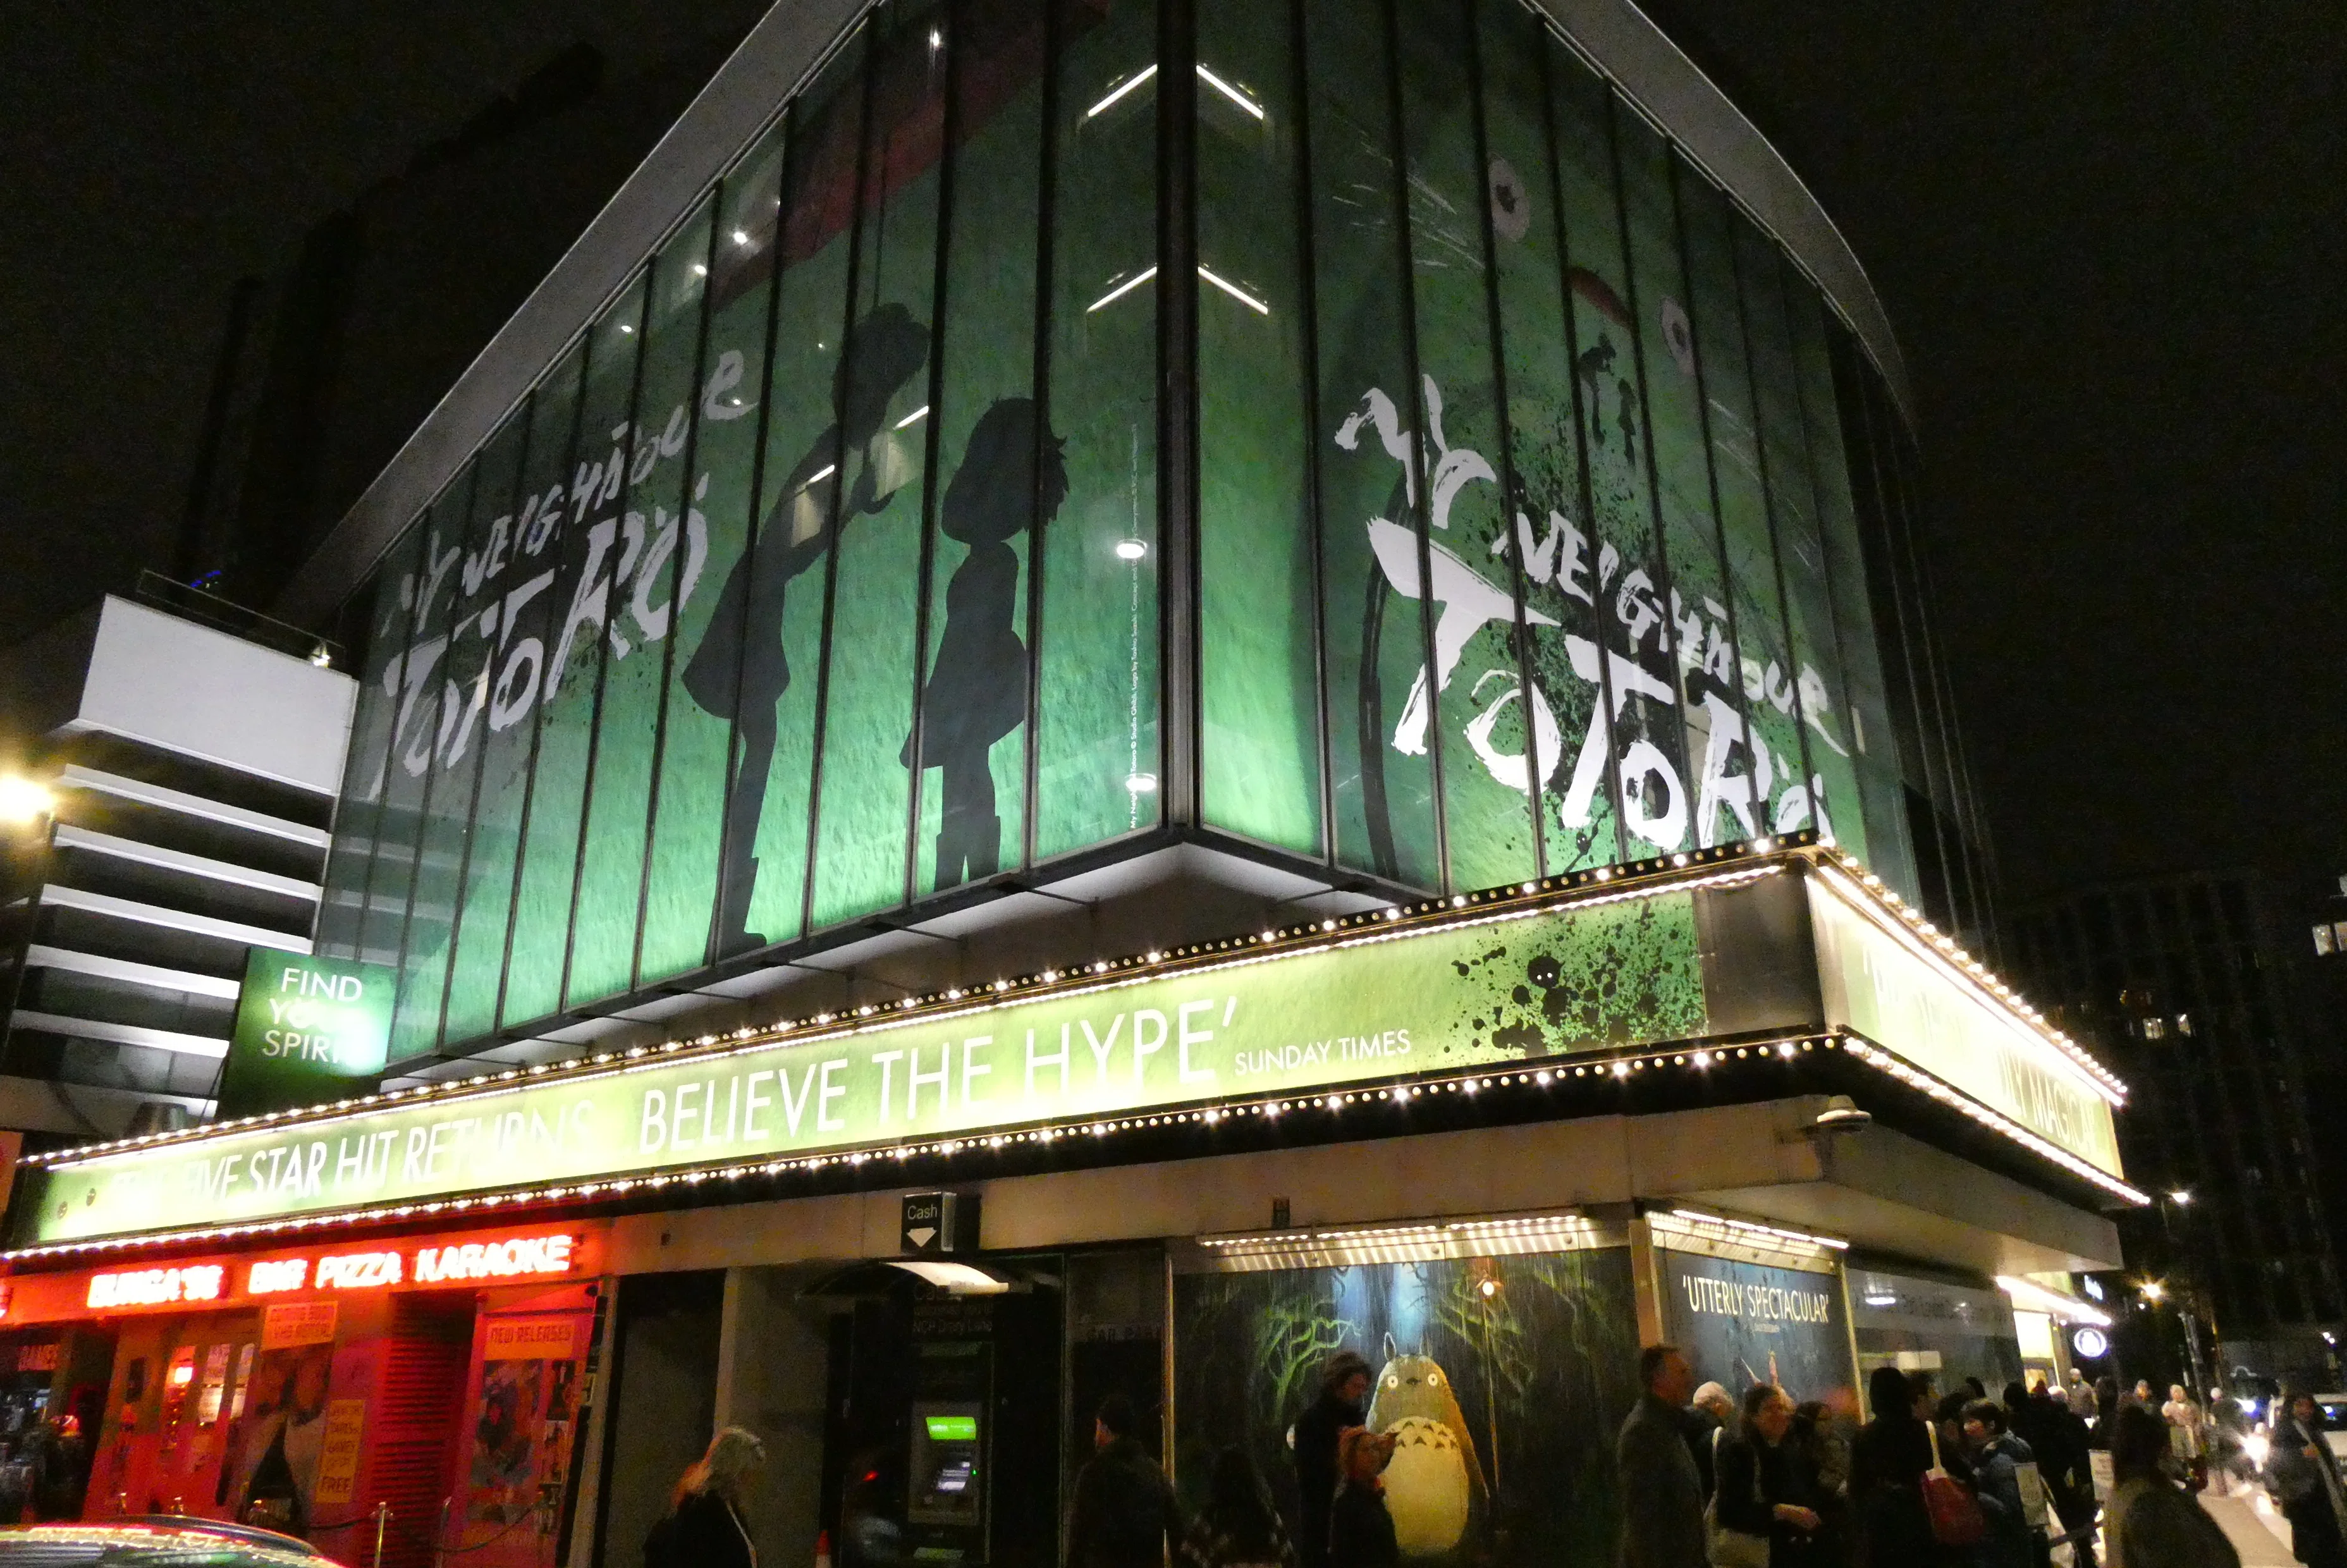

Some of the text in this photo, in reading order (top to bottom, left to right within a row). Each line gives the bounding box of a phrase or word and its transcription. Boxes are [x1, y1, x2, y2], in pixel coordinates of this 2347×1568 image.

[1335, 374, 1497, 530] MY
[367, 474, 709, 801] TOTORO
[1491, 511, 1849, 757] NEIGHBOUR
[1131, 661, 1139, 671] by
[1366, 517, 1834, 851] TOTORO
[1130, 815, 1137, 828] My
[281, 967, 362, 1002] FIND
[262, 1029, 355, 1066] SPIRI
[1234, 1029, 1411, 1076] SUNDAY TIMES
[639, 1058, 848, 1155] BELIEVE
[872, 1035, 993, 1124] THE
[249, 1141, 327, 1201] STAR
[333, 1129, 399, 1192] HIT
[403, 1099, 596, 1185] RETURNS
[907, 1204, 938, 1220] Cash
[248, 1235, 573, 1294] BAR PIZZA KARAOKE
[516, 1324, 572, 1342] RELEASES
[321, 1476, 352, 1493] FREE
